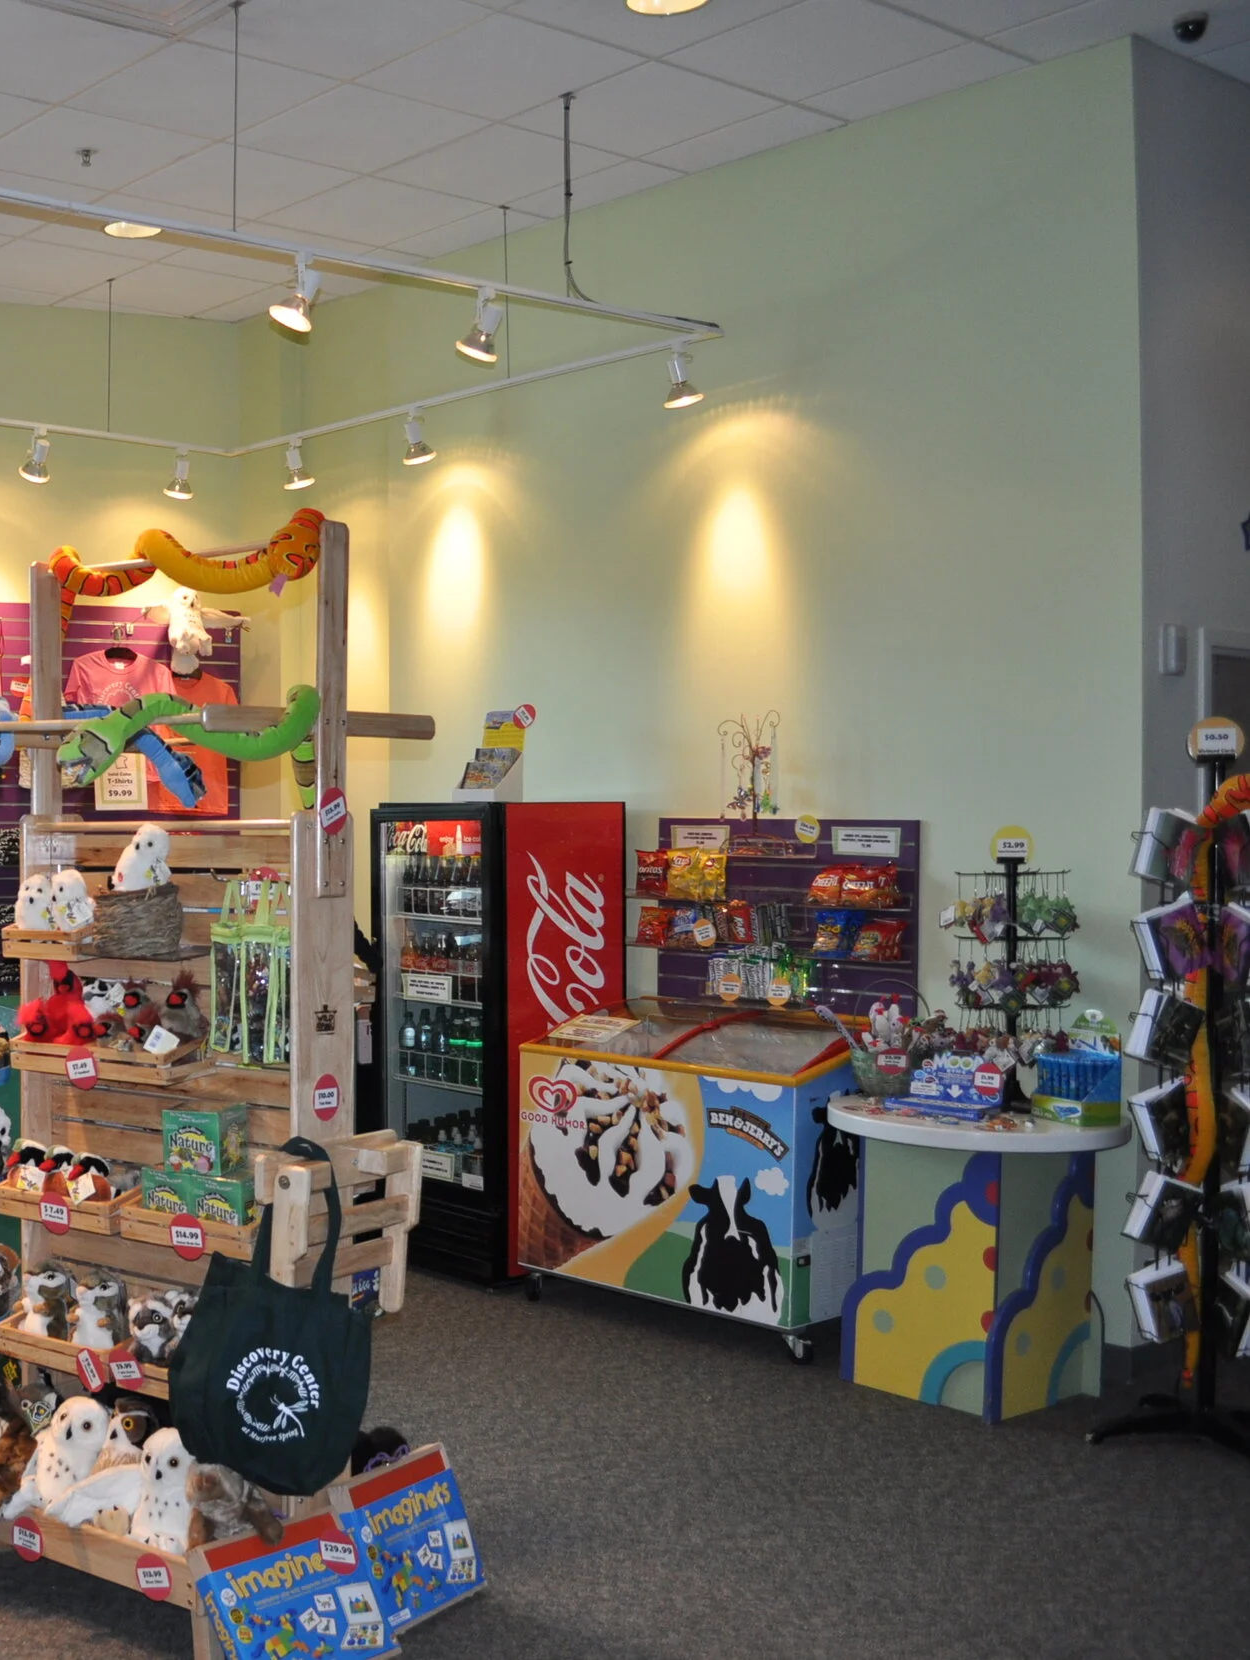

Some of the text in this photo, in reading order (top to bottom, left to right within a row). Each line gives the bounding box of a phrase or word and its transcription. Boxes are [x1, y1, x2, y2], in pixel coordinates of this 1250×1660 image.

[108, 789, 133, 797] $9.99
[521, 1111, 585, 1129] GOOD HUMOR
[169, 1131, 215, 1155] Nature
[710, 1112, 784, 1156] BEN & JERRY'S
[148, 1191, 187, 1213] Nature
[196, 1197, 238, 1222] Nature
[175, 1230, 199, 1240] $14.99
[226, 1347, 320, 1409] Discovery Center
[241, 1426, 250, 1434] at
[278, 1428, 299, 1442] Spring
[365, 1482, 451, 1536] imaginets
[323, 1543, 353, 1555] $29.99
[225, 1552, 326, 1599] imagine
